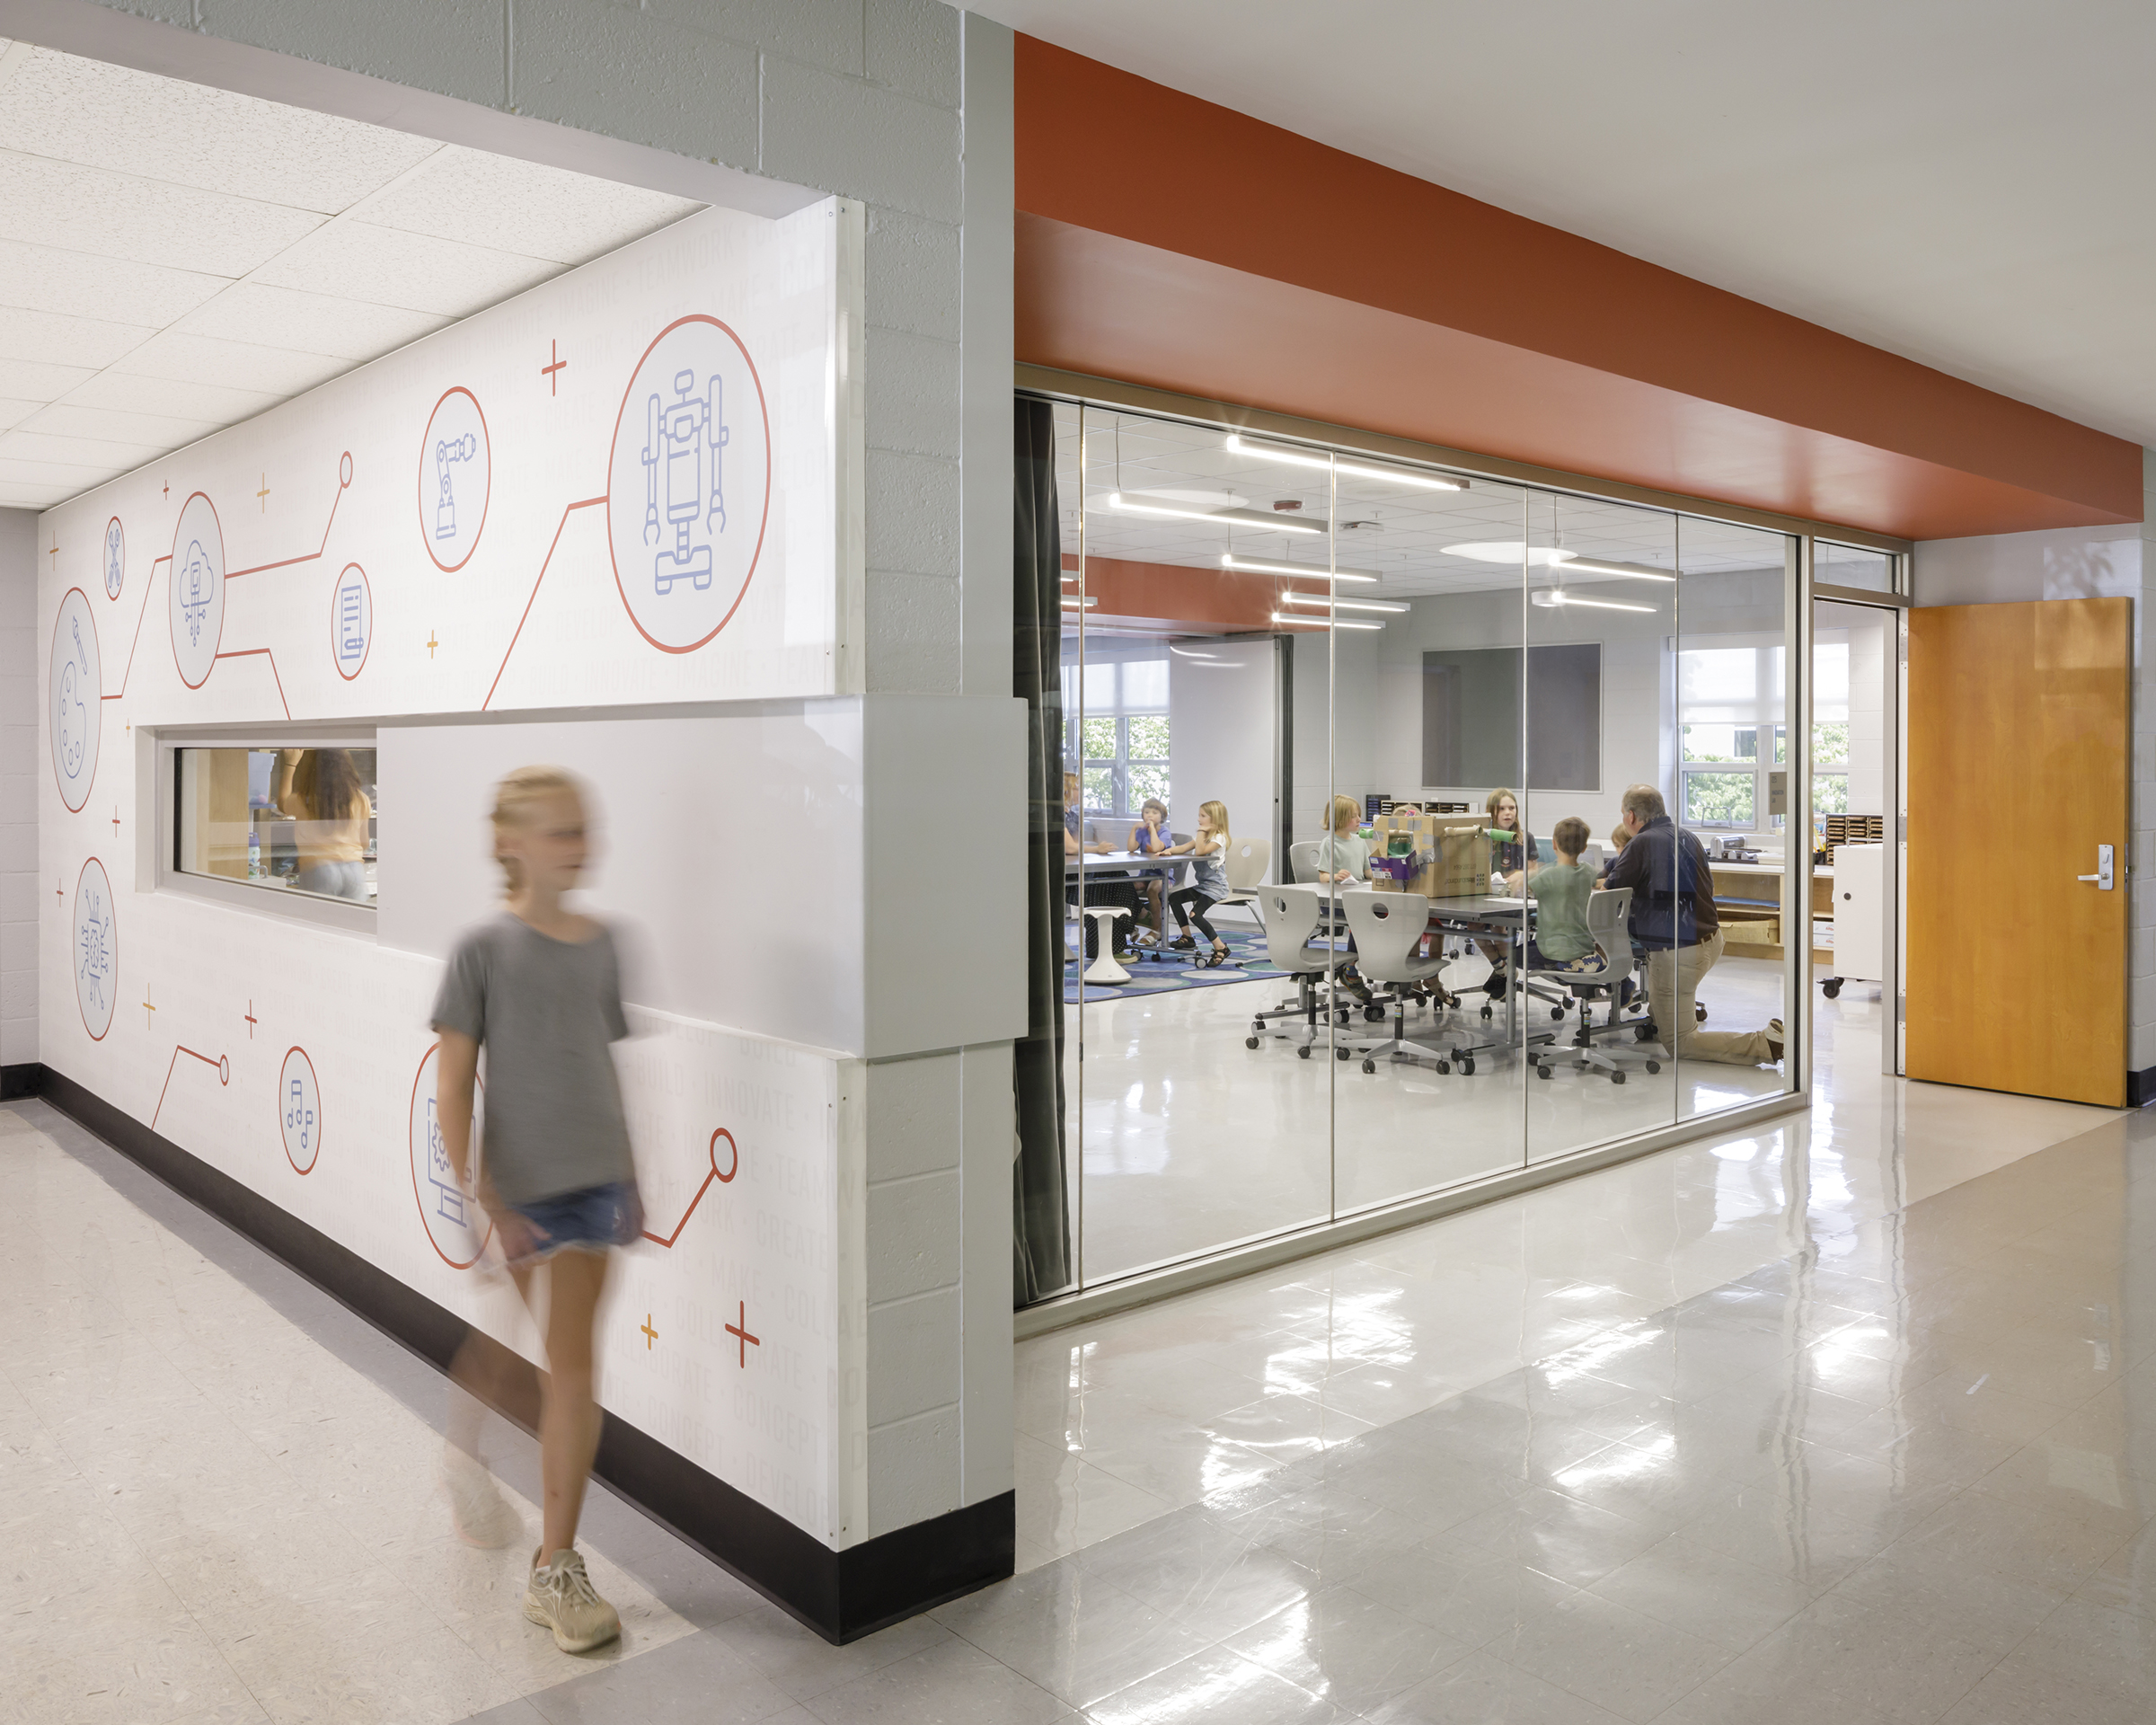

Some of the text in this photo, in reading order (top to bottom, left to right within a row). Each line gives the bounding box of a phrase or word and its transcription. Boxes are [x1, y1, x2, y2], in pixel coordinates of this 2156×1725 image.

[438, 333, 471, 376] BUILD
[483, 302, 543, 357] INNOVATE
[559, 269, 620, 326] IMAGINE
[637, 218, 733, 295] TEAMWORK
[541, 390, 594, 438] CREATE
[553, 606, 617, 644] DEVELOP
[530, 664, 569, 697] BUILD
[585, 658, 658, 695] INNOVATE
[678, 650, 755, 692] IMAGINE
[637, 1052, 684, 1097] BUILD
[704, 1071, 794, 1132] INNOVATE
[755, 1208, 827, 1274] CREATE
[711, 1248, 762, 1308] MAKE
[647, 1393, 723, 1472] CONCEPT
[732, 1382, 821, 1465] CONCEPT
